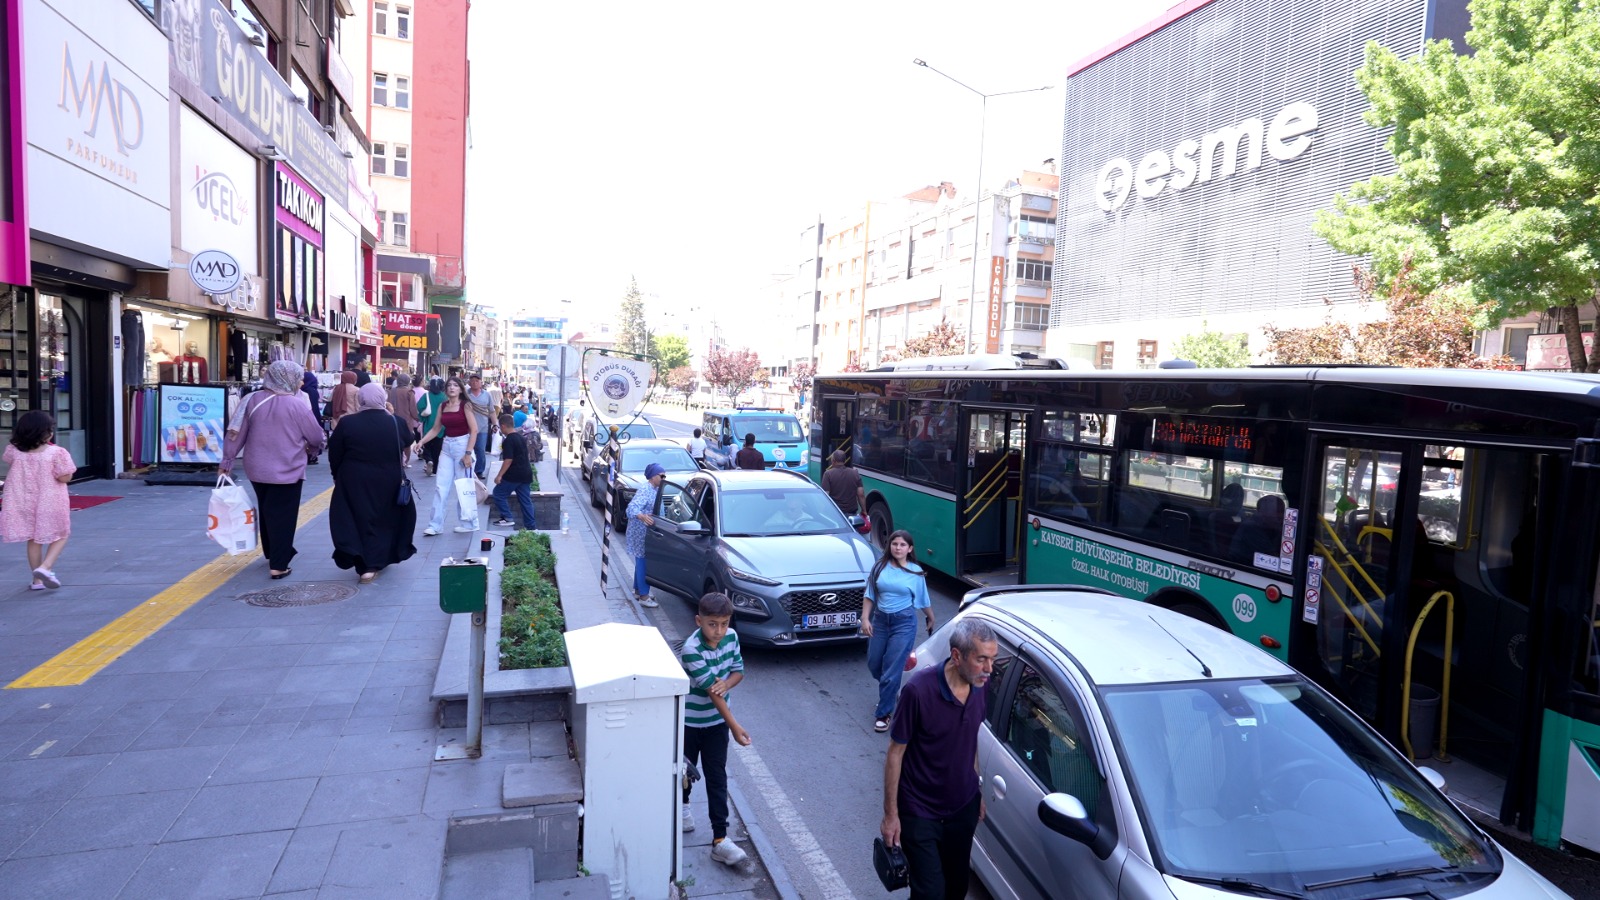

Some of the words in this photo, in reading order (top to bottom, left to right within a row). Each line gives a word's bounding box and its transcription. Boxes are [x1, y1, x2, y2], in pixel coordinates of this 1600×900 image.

[57, 41, 144, 157] MAD
[212, 14, 293, 158] GOLDEN
[66, 137, 138, 184] PARFUMEUR
[296, 114, 325, 159] FITNESS
[325, 145, 347, 181] CENTER
[195, 260, 237, 278] MAD
[383, 334, 427, 349] KABI
[593, 363, 620, 382] OTOBÜS
[621, 364, 642, 388] DURAĞI
[1040, 530, 1074, 550] KAYSERİ
[1075, 538, 1134, 570] BÜYÜKŞEHİR
[1135, 559, 1201, 591] BELEDİYESİ
[1071, 557, 1090, 574] ÖZEL
[1090, 565, 1110, 582] HALK
[1110, 573, 1150, 595] OTOBÜSÜ
[808, 616, 818, 625] 09
[841, 613, 856, 622] 956
[1234, 599, 1255, 618] 099
